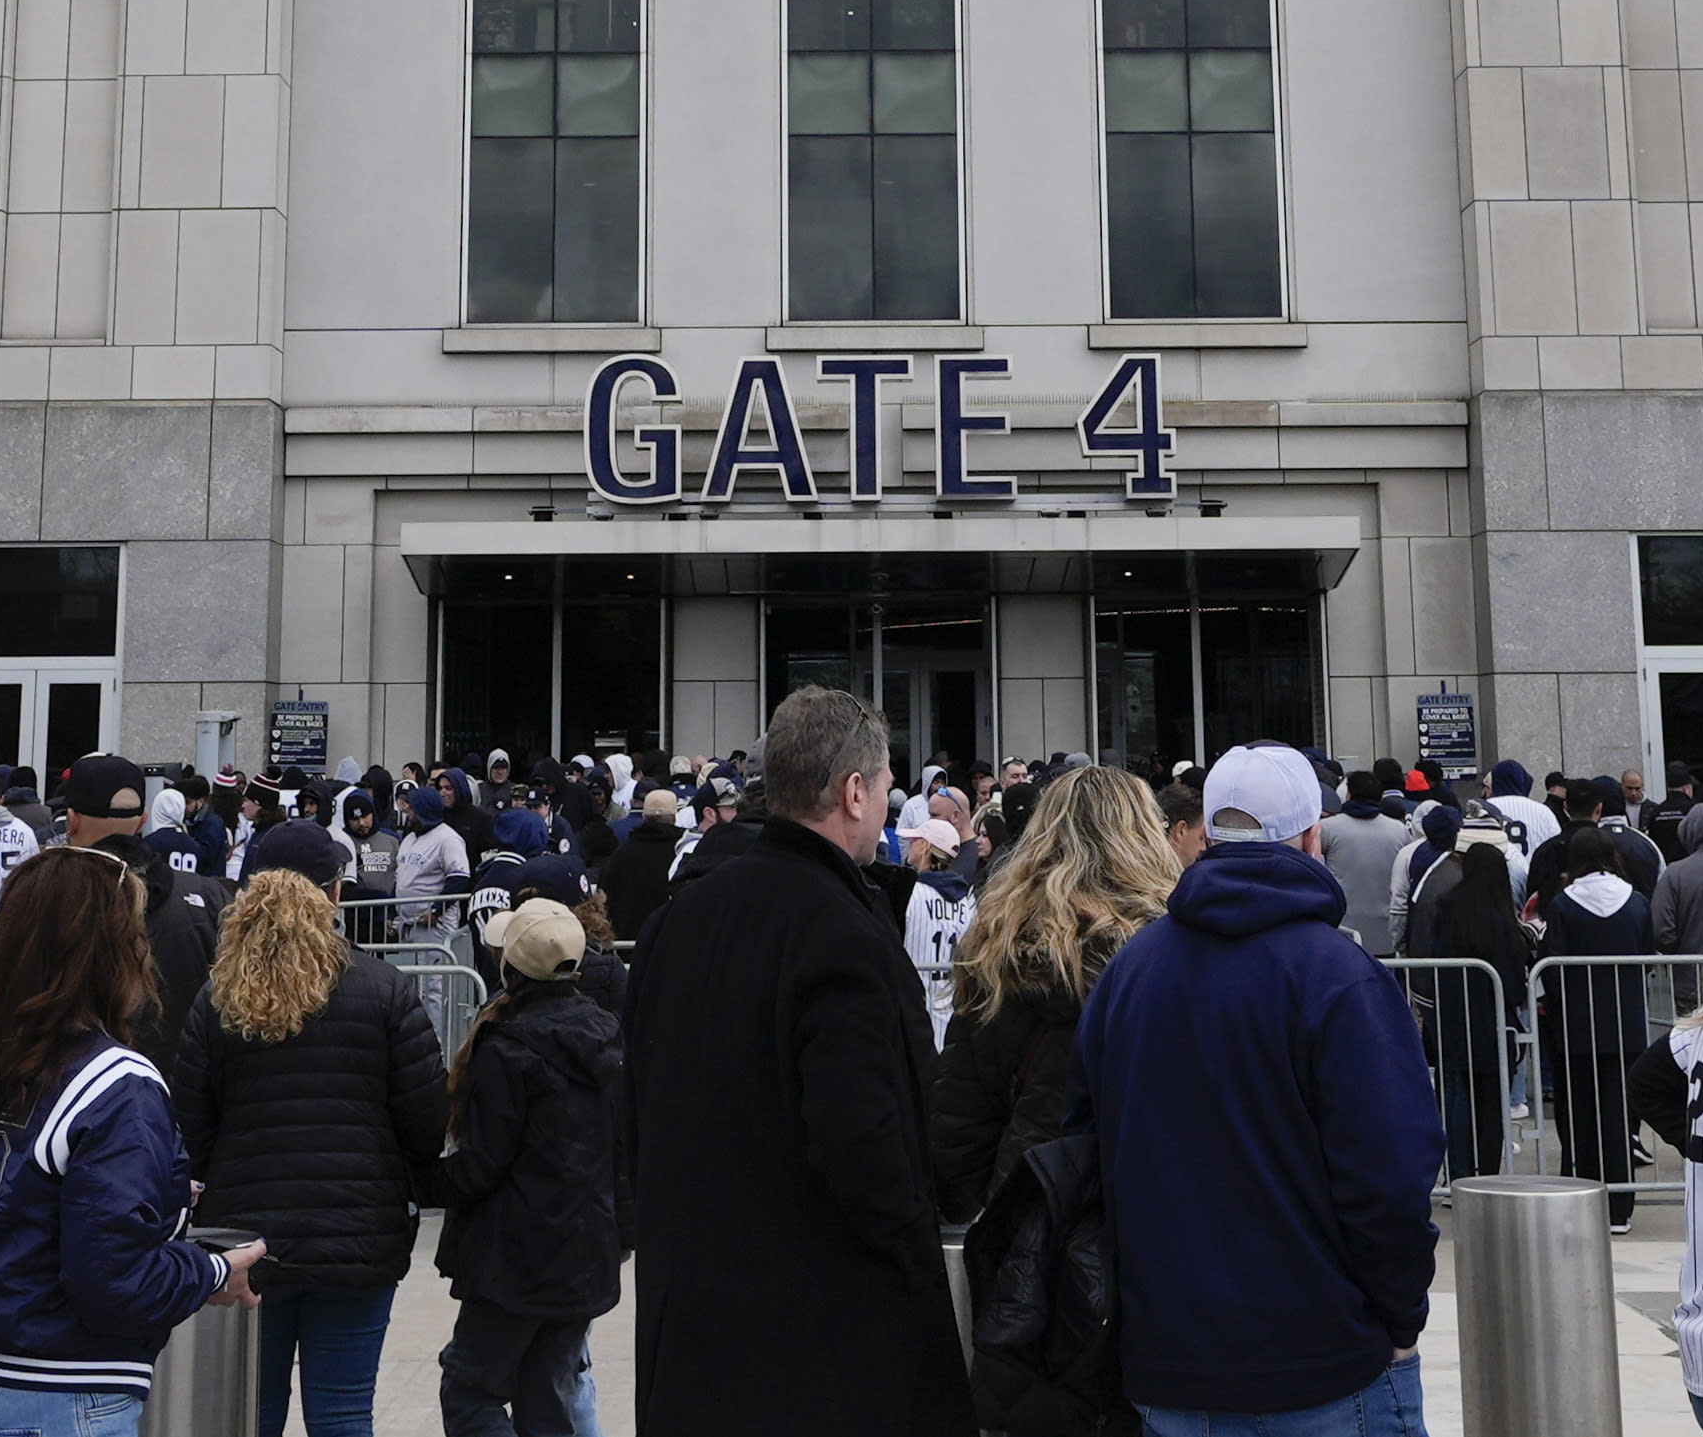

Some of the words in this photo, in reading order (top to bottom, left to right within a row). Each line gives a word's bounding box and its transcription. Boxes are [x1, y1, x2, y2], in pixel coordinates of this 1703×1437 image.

[584, 353, 1018, 506] GATE
[1075, 352, 1178, 500] 4
[925, 898, 966, 925] VOLPE
[932, 931, 958, 981] 11
